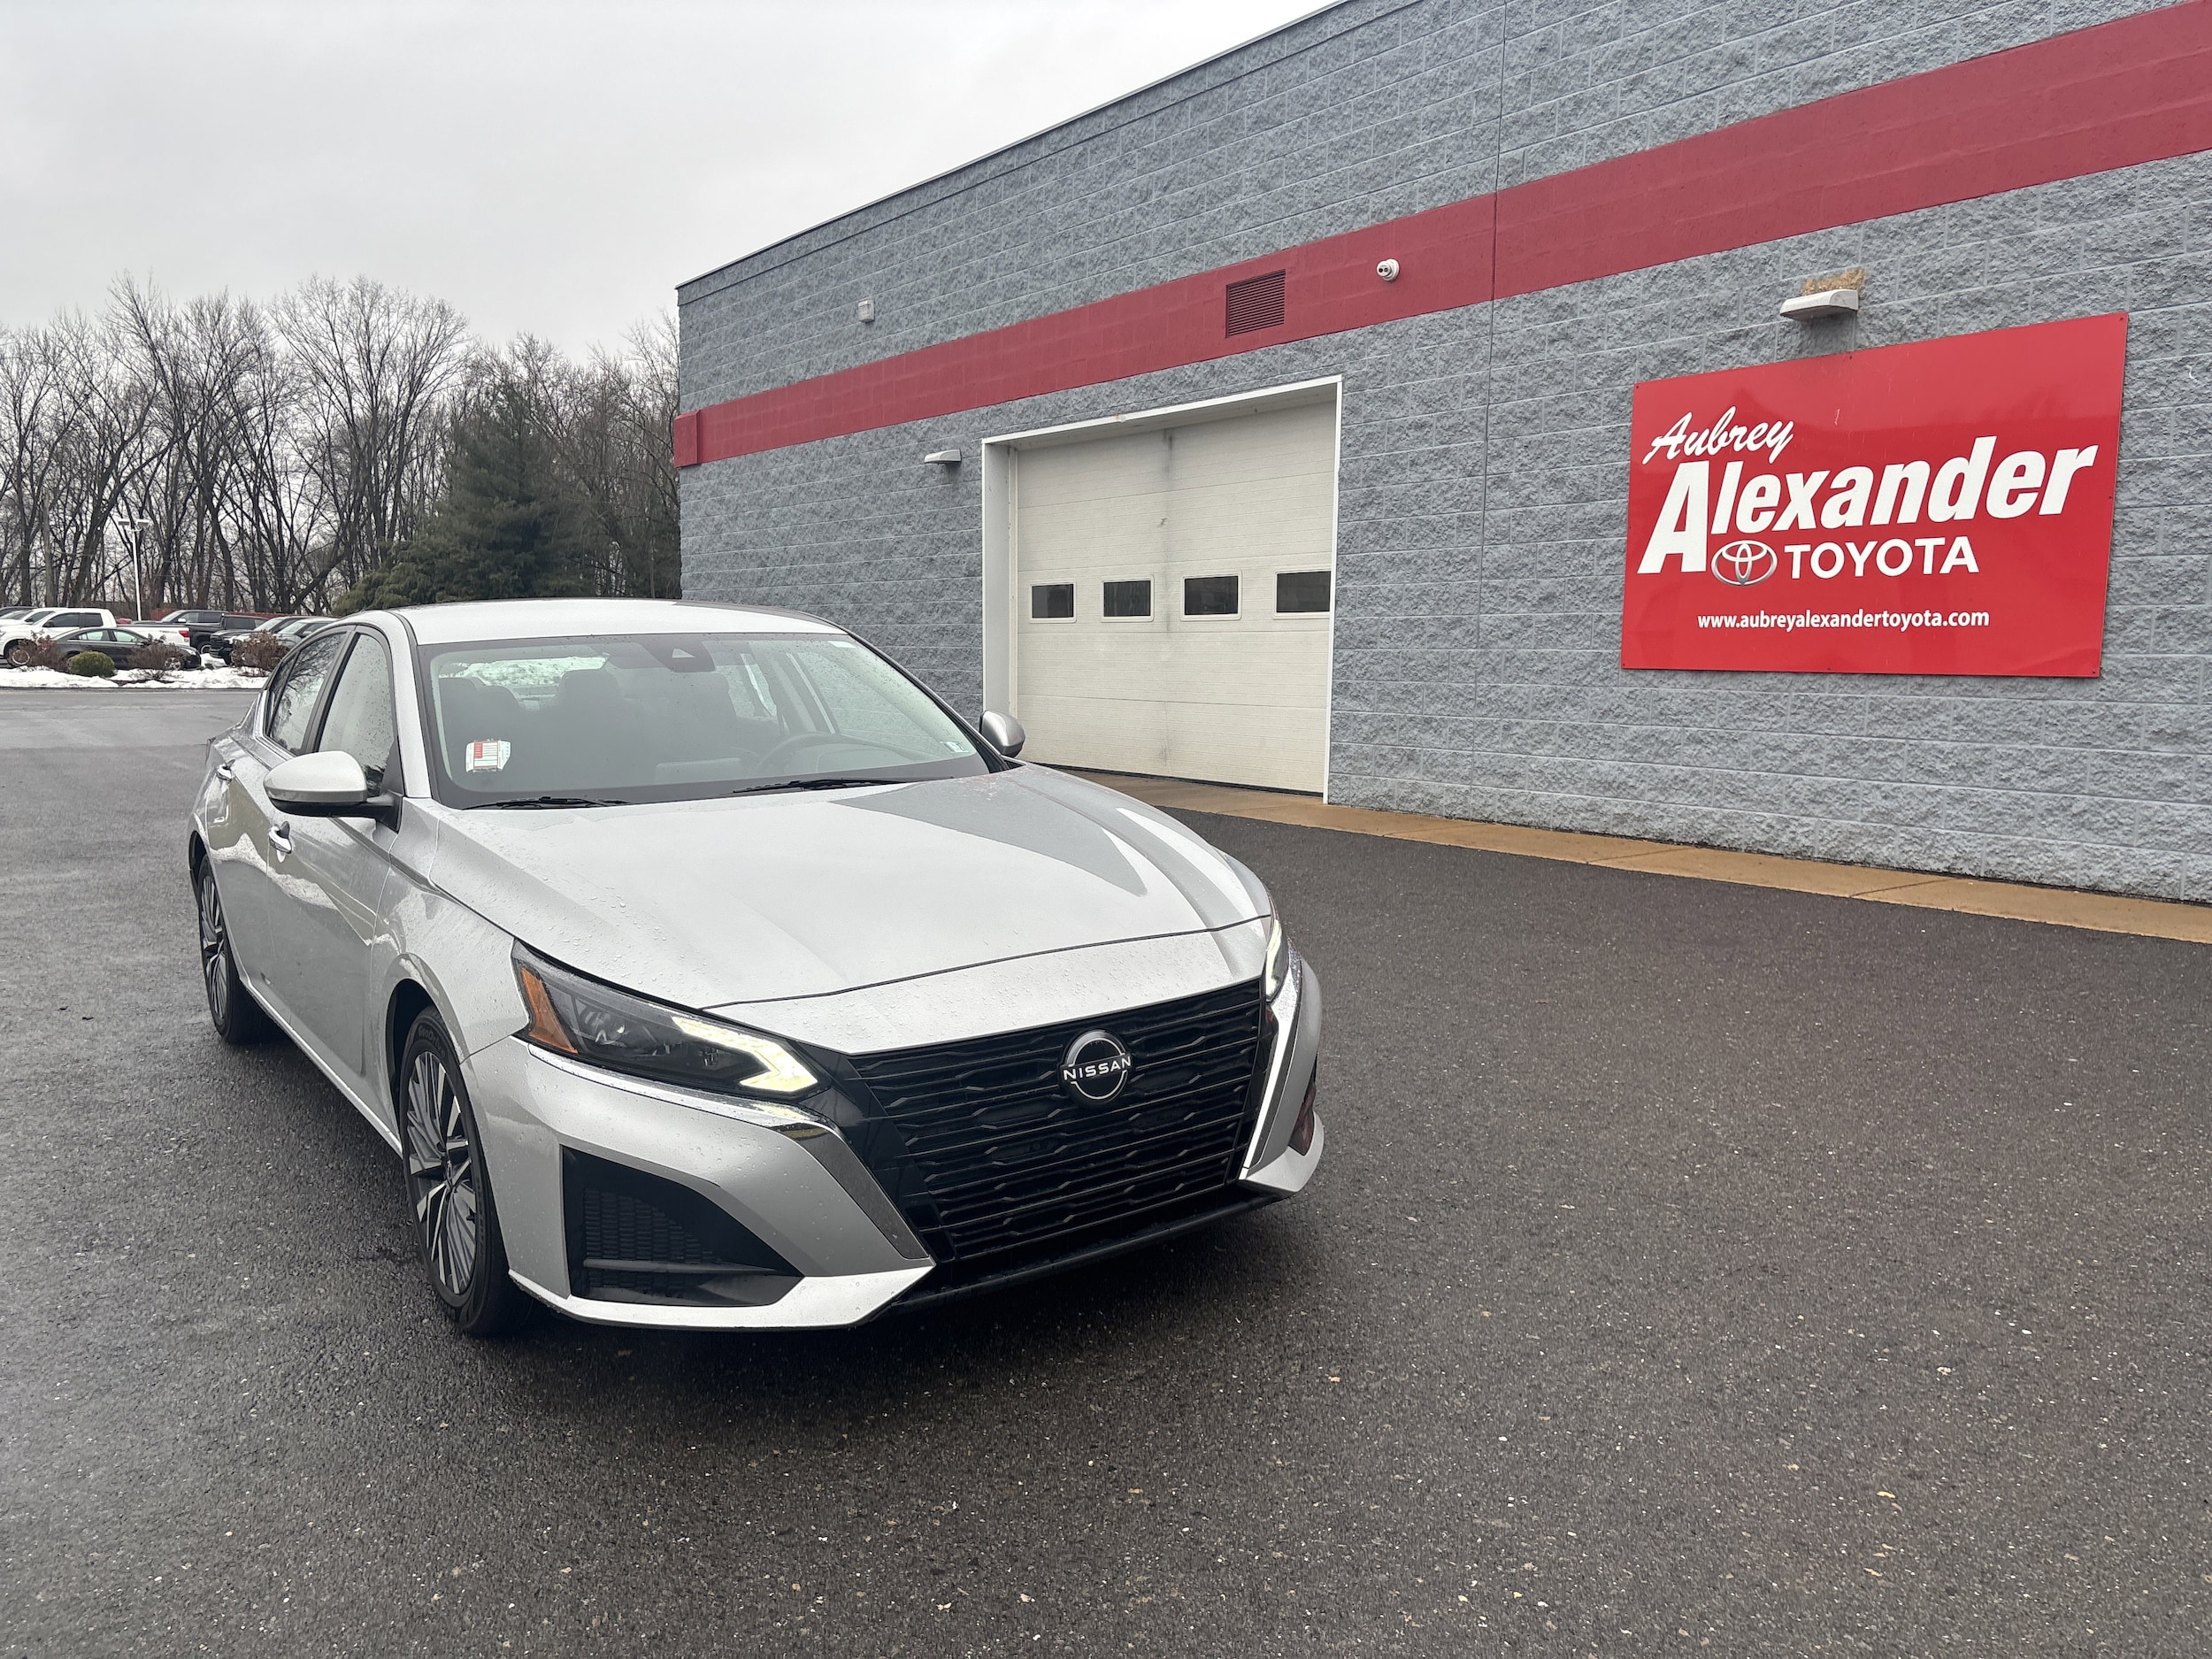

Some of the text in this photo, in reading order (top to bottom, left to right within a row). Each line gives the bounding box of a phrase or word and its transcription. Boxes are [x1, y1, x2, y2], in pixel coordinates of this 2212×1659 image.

[1642, 406, 1794, 465] Aubrey
[1638, 436, 2098, 573] Alexander
[1784, 536, 1979, 580] TOYOTA
[1698, 609, 1989, 633] www.aubreyalexandertoyota.com
[1064, 1056, 1131, 1080] NISSAN
